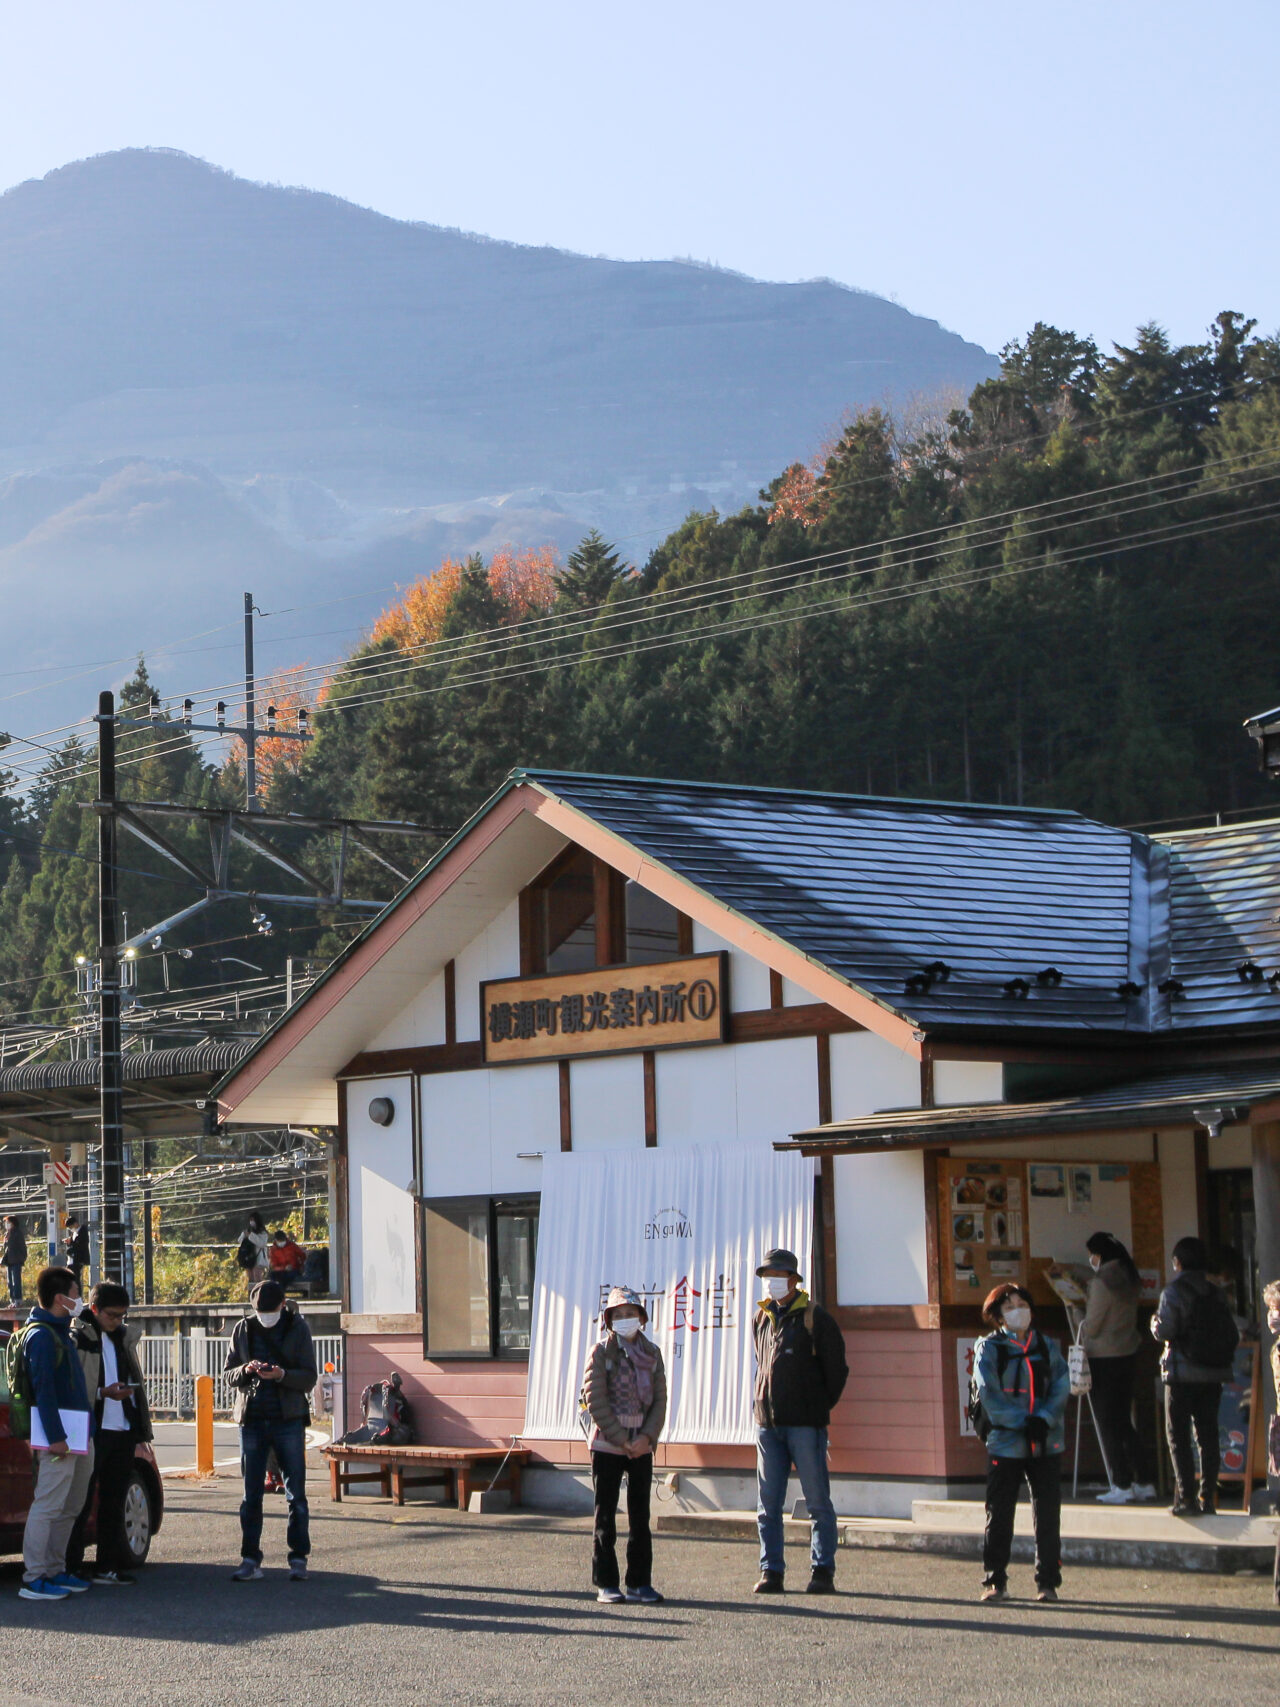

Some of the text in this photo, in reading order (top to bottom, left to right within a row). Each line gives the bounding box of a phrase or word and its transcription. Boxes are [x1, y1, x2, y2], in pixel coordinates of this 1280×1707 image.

[489, 982, 687, 1043] 横瀬町観光案内所
